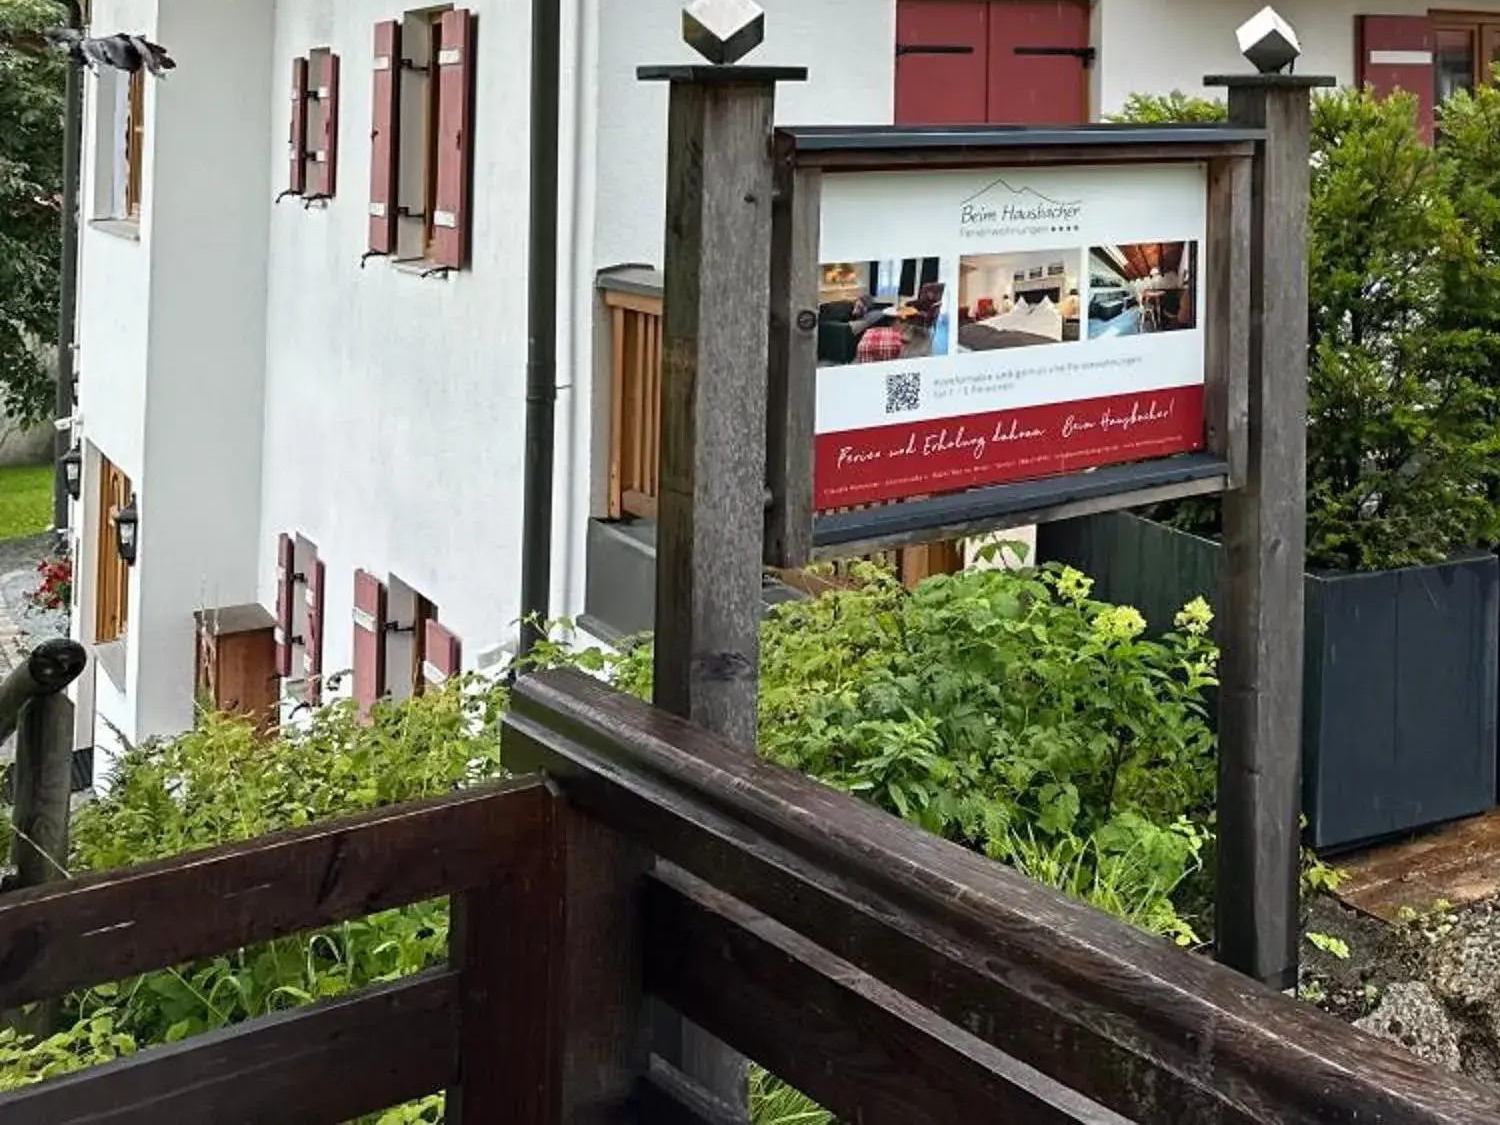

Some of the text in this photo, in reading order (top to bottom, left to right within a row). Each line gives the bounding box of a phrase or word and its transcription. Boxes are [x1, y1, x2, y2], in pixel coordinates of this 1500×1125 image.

[960, 202, 1081, 224] Beim Hausbacher
[837, 446, 881, 469] Ferien
[889, 432, 917, 458] und
[922, 426, 987, 459] Erholung
[1061, 414, 1096, 438] Beim
